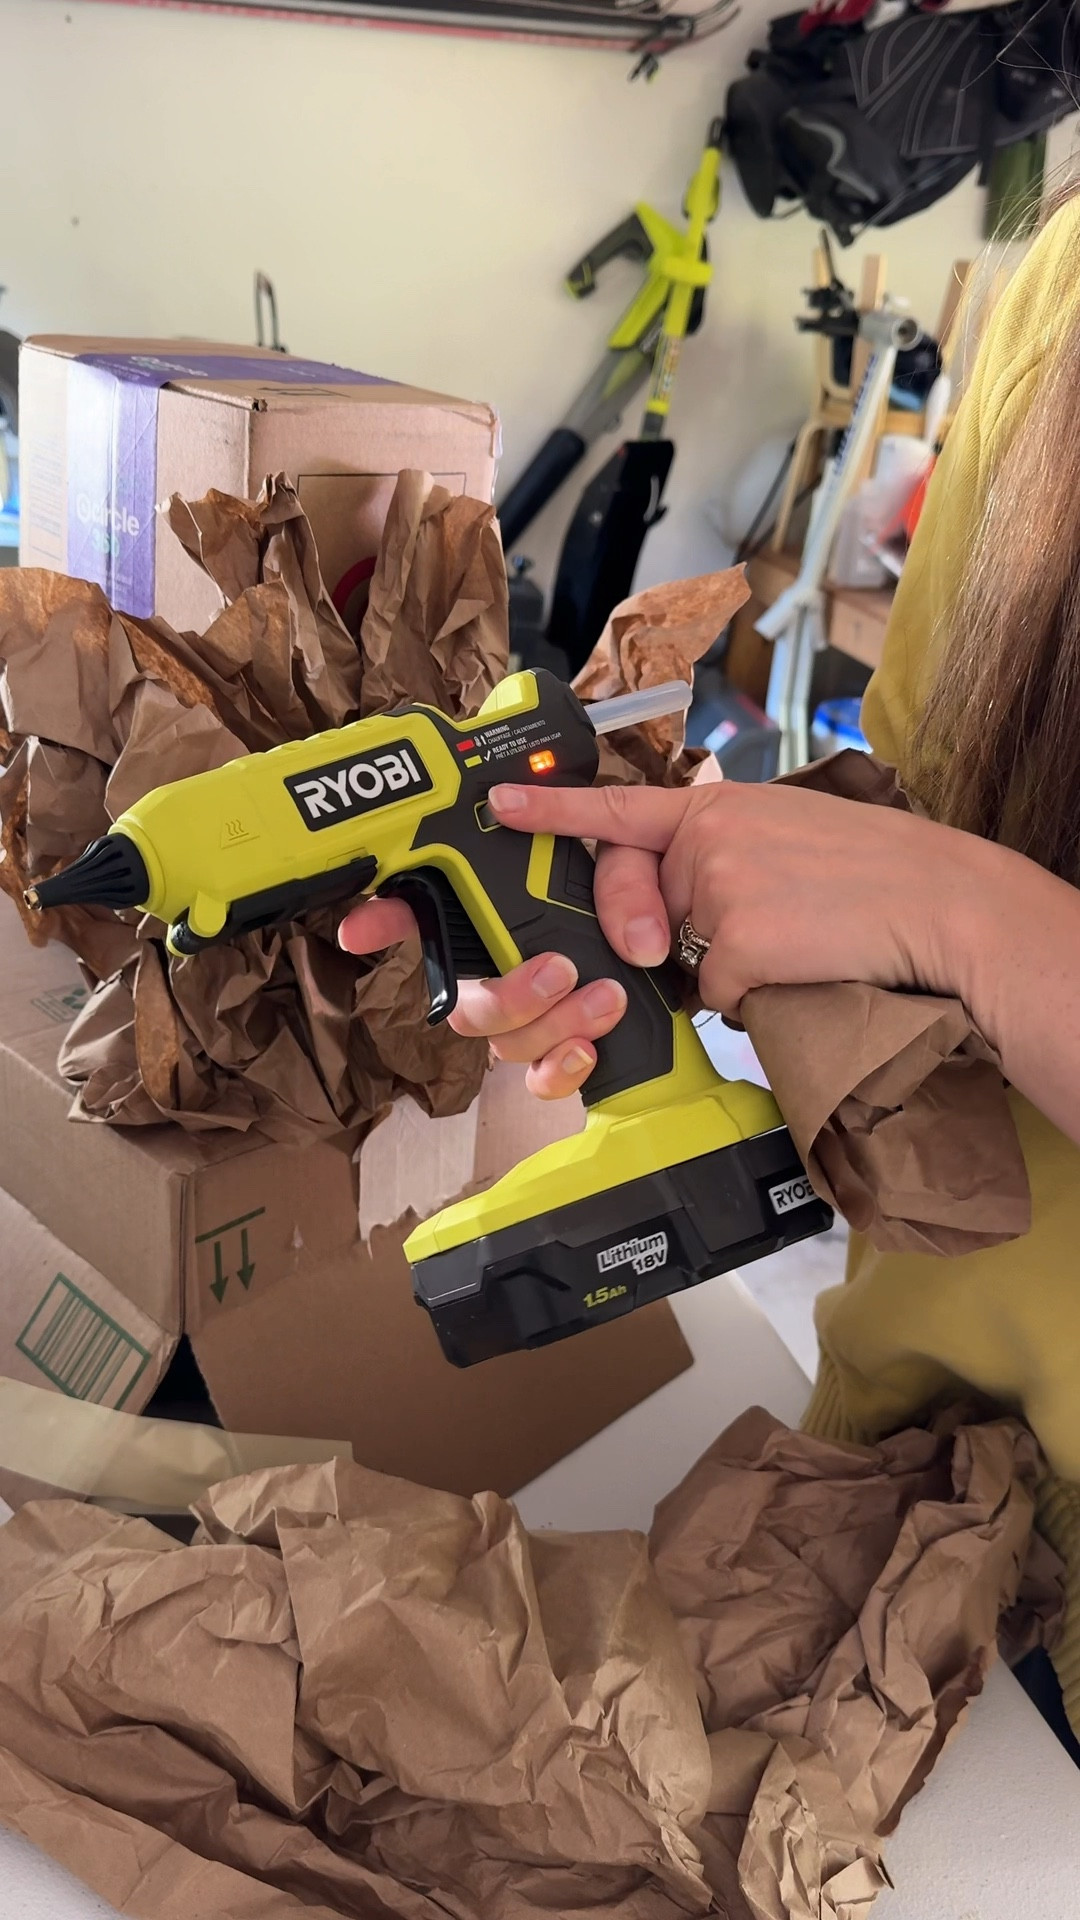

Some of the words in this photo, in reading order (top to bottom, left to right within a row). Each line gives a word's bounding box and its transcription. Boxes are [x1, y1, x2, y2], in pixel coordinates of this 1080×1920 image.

[484, 725, 510, 738] WARMING
[540, 736, 551, 744] PARA
[492, 743, 508, 754] READY
[509, 740, 517, 748] TO
[516, 737, 527, 746] USE
[294, 749, 421, 818] RYOBI
[773, 1179, 815, 1208] RYOB
[600, 1235, 664, 1268] Lithium
[635, 1249, 665, 1271] 18V
